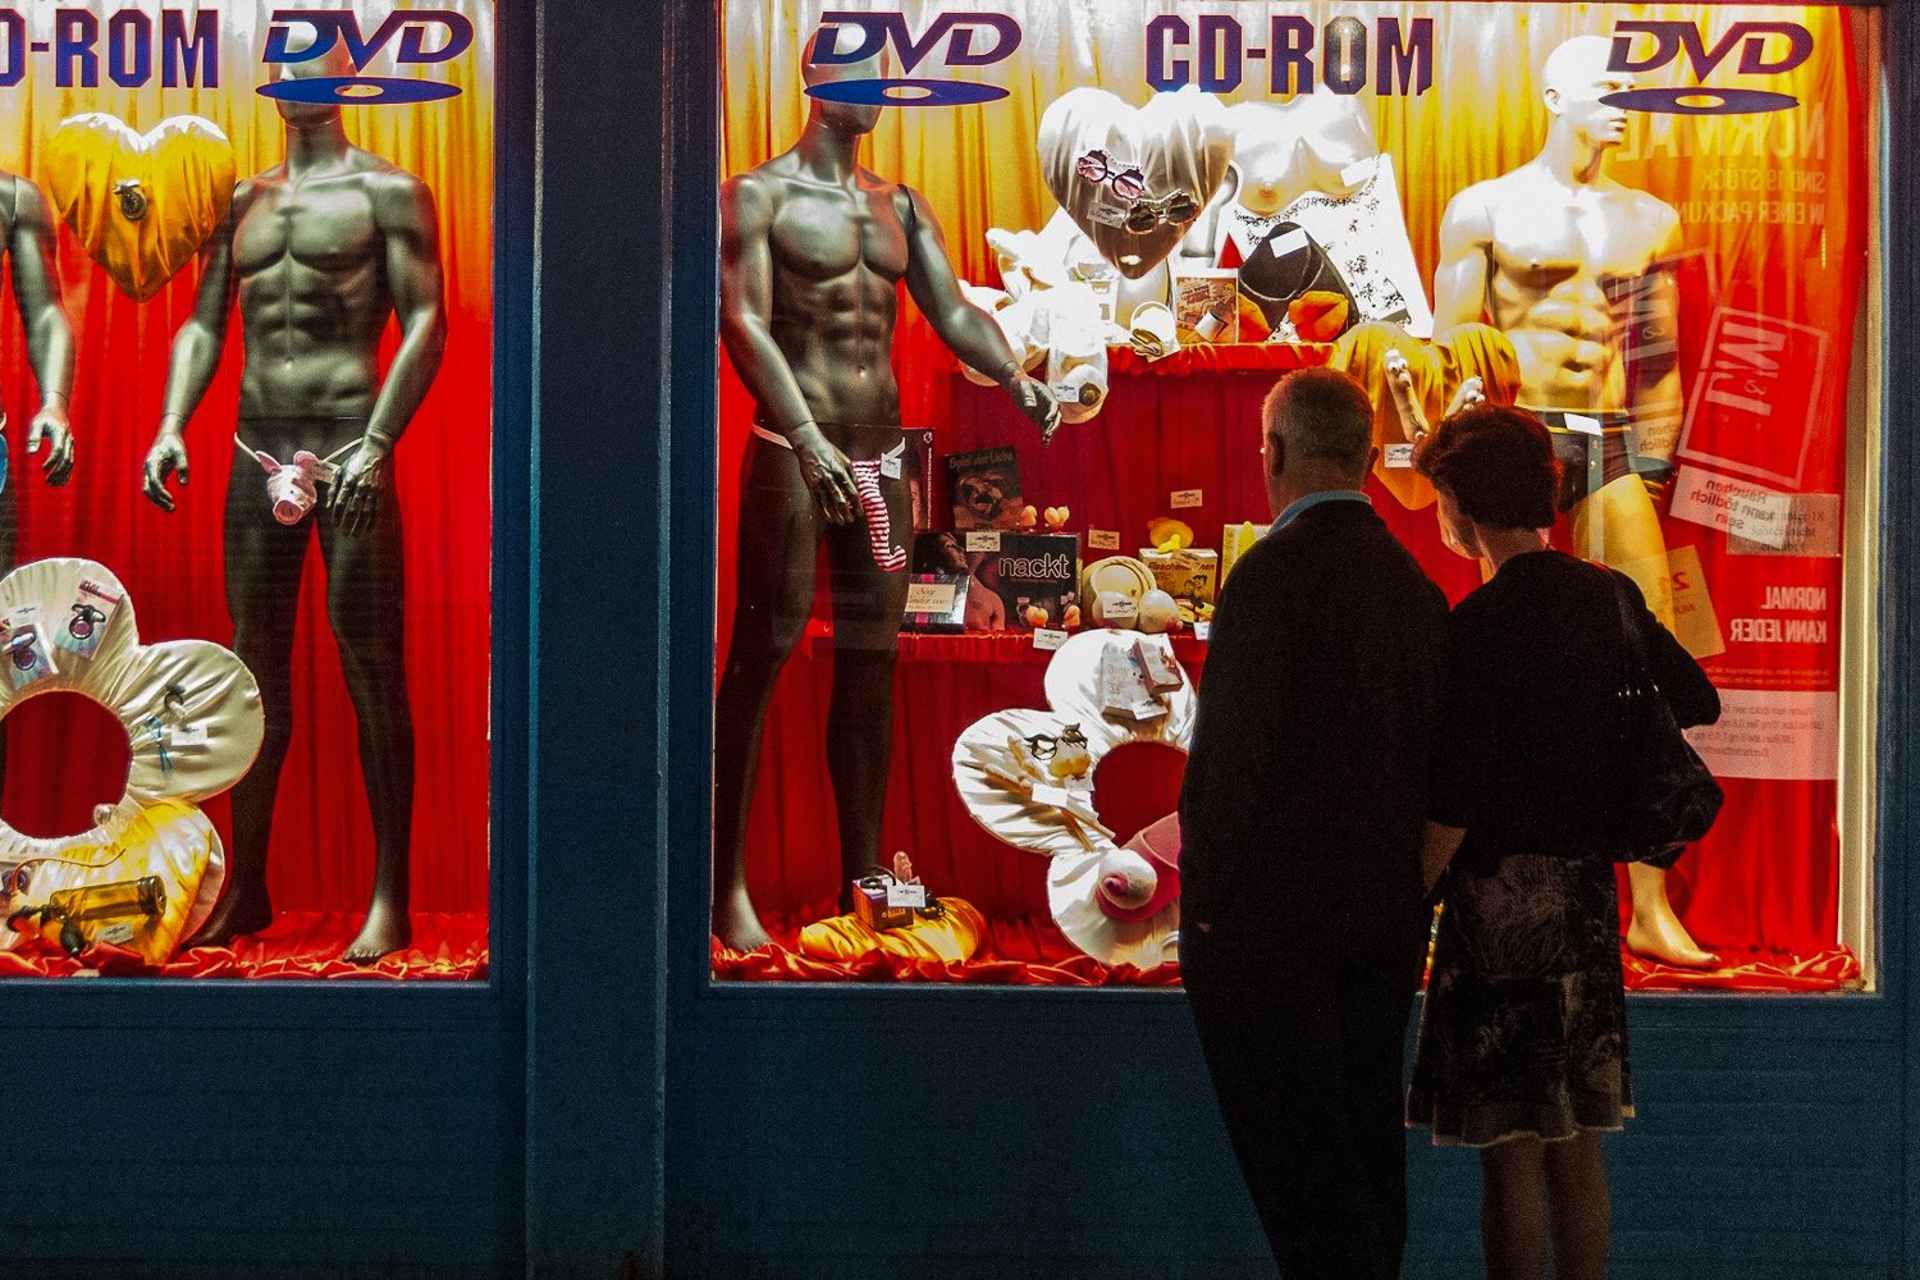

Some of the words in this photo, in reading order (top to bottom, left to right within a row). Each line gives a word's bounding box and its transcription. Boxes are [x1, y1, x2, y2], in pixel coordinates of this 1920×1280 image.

[262, 9, 474, 72] DVD
[808, 11, 1023, 75] DVD
[1145, 15, 1433, 96] CD-ROM
[1606, 20, 1814, 84] DVD
[998, 552, 1071, 579] nackt
